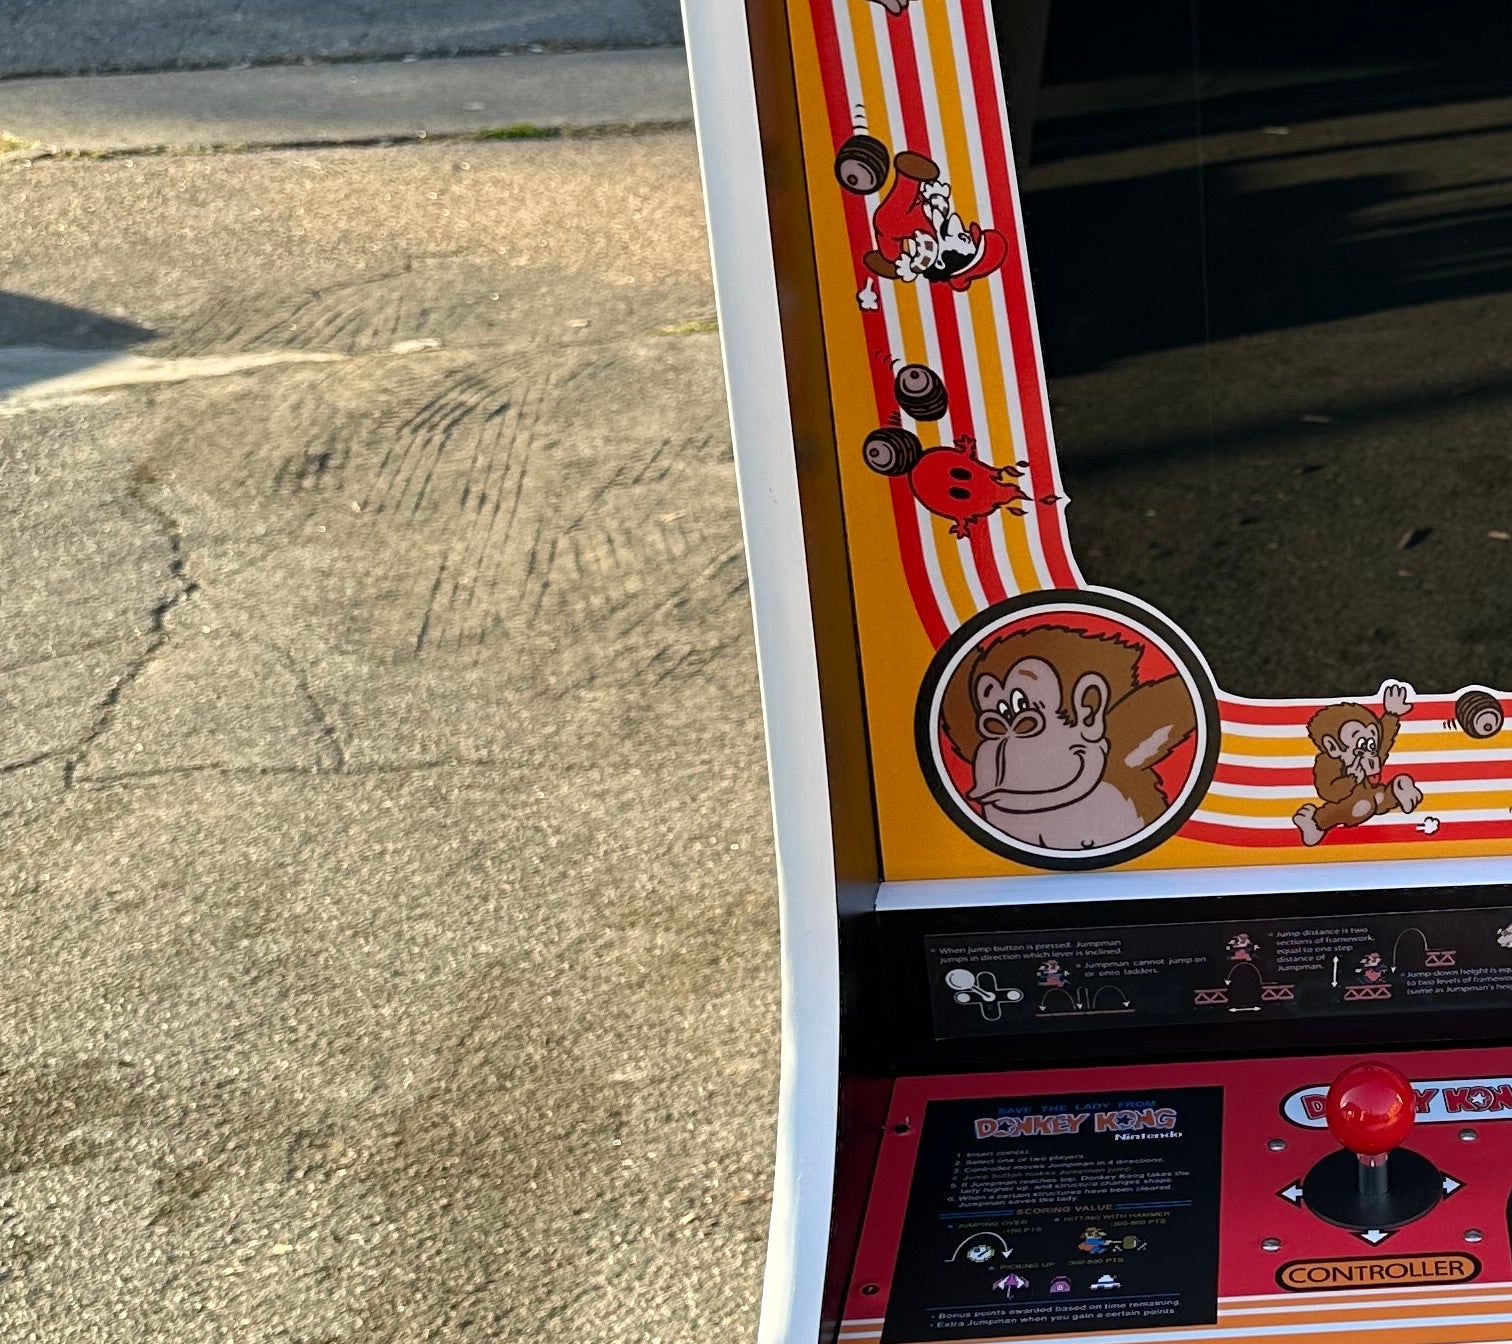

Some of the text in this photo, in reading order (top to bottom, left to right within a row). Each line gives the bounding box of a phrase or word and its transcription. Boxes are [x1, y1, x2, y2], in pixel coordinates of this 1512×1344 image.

[974, 1108, 1178, 1139] DONKEY KONG
[1114, 1131, 1183, 1141] Nintendo
[1015, 1203, 1114, 1215] SCORING VALUE
[1288, 1260, 1465, 1284] CONTROLLER
